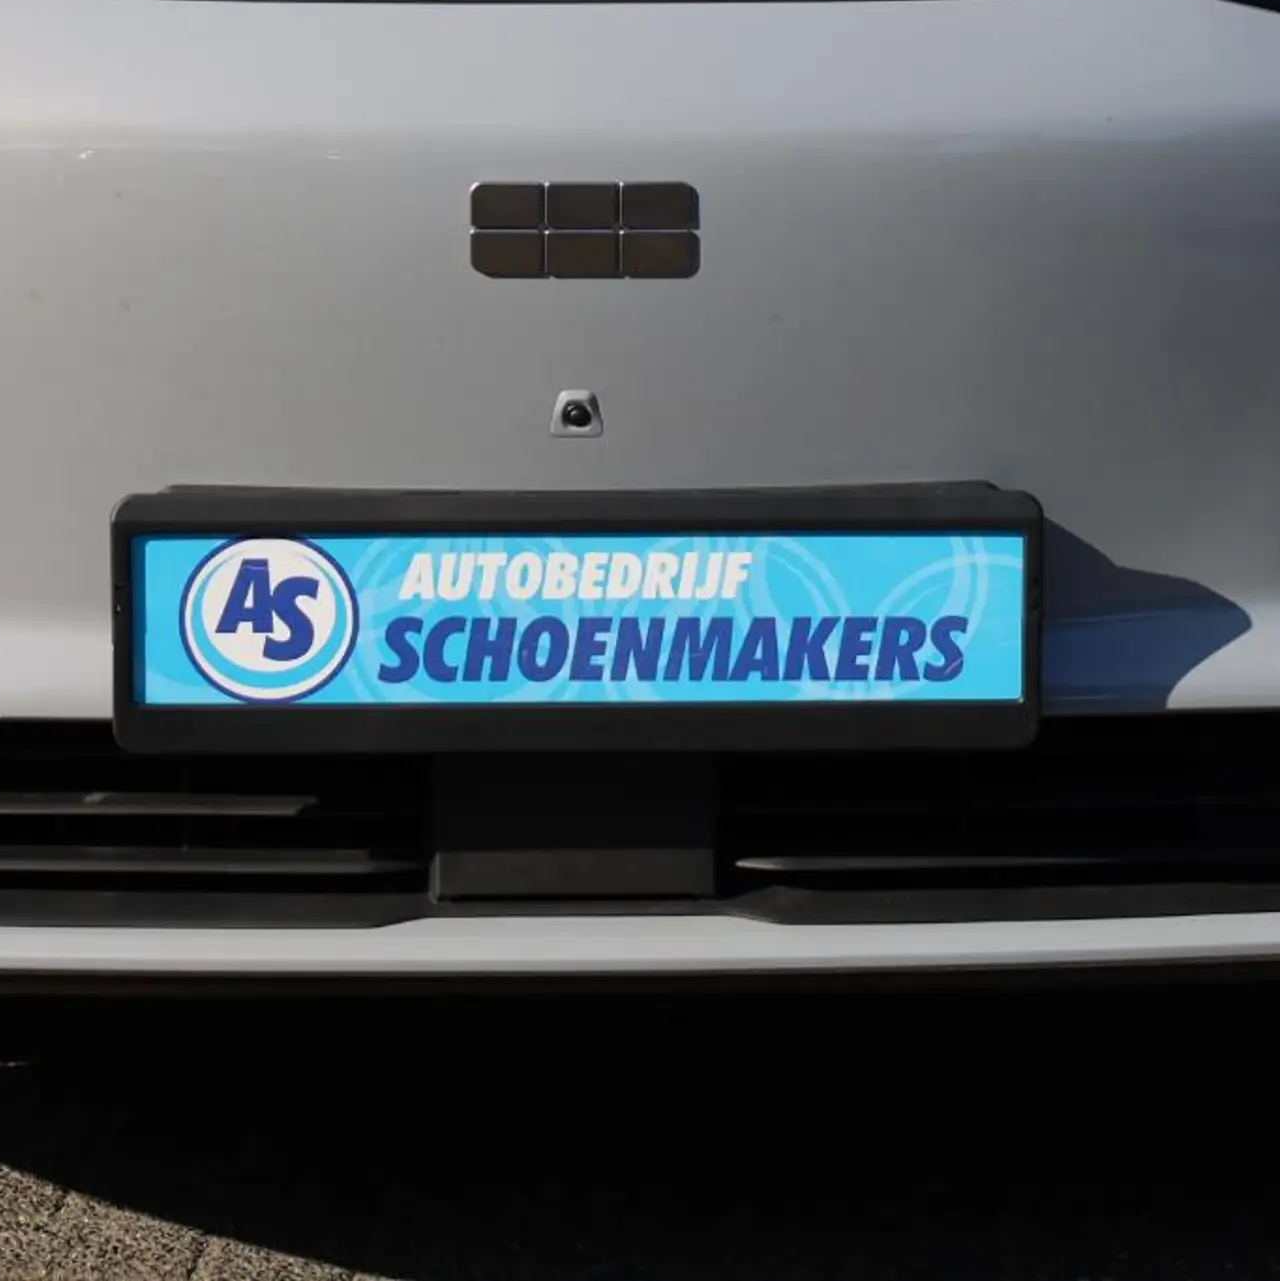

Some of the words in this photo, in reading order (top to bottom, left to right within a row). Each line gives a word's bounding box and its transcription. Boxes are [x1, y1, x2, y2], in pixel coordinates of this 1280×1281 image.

[215, 558, 320, 661] AS
[399, 551, 753, 601] AUTOBEDRIJF
[378, 615, 969, 683] SCHOENMAKERS
